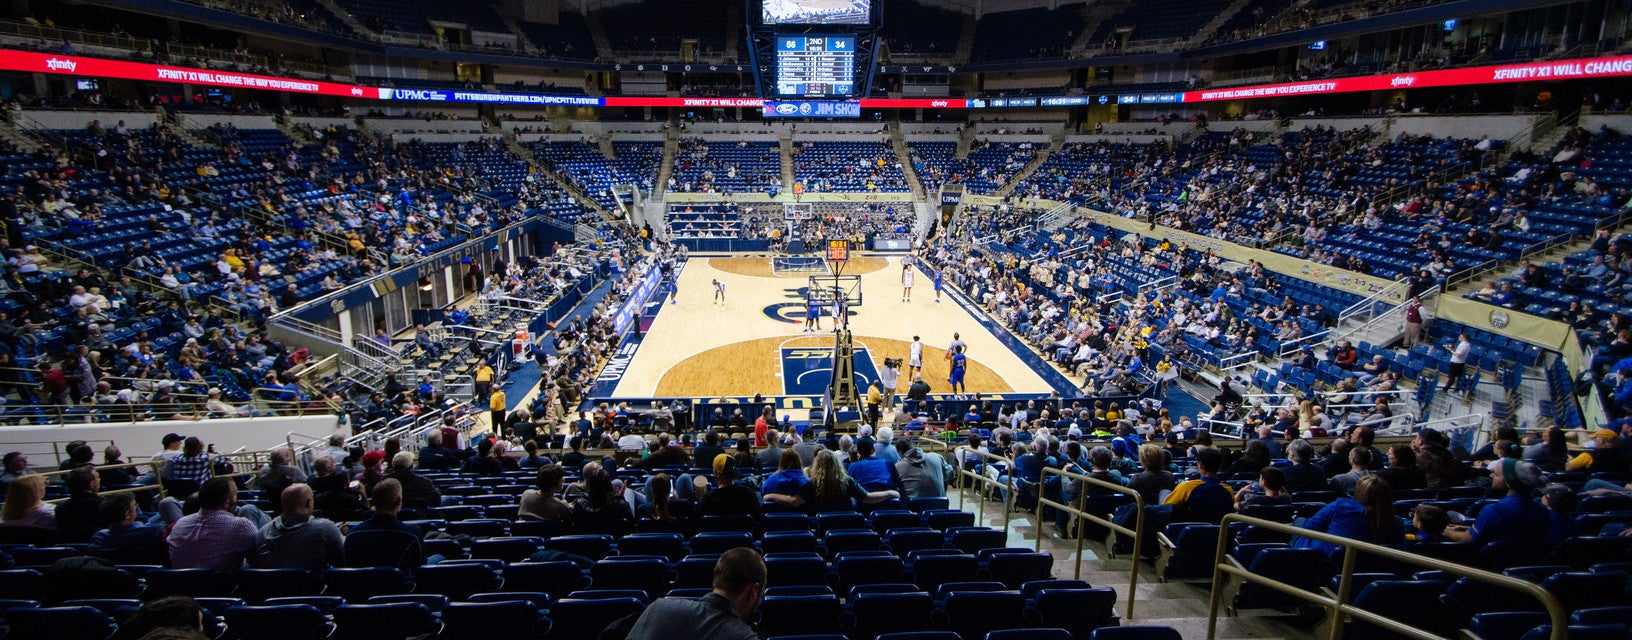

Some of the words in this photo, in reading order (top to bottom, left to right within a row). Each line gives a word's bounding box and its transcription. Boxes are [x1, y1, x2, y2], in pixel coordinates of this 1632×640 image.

[46, 57, 77, 72] xfinity
[1493, 67, 1536, 80] XFINITY
[1537, 66, 1551, 77] X1
[1553, 63, 1582, 76] WILL
[157, 68, 188, 81] XFINITY
[188, 71, 198, 81] X1
[198, 72, 216, 83] WILL
[215, 74, 243, 85] CHANGE
[243, 77, 256, 87] THE
[255, 78, 269, 87] WAY
[268, 79, 281, 89] YOU
[281, 80, 312, 91] EXPERIENCE
[312, 83, 319, 92] TV
[1391, 76, 1413, 87] xfinity
[395, 89, 430, 100] UPMC
[1201, 92, 1219, 100] XFINITY
[1223, 91, 1235, 99] WILL
[1235, 90, 1255, 98] CHANGE
[1255, 88, 1265, 96] THE
[1277, 86, 1289, 94] YOU
[1289, 84, 1326, 93] EXPERIENCE
[1325, 82, 1336, 91] TV
[815, 103, 834, 115] JIM
[418, 258, 445, 278] HAIL
[448, 251, 462, 264] TO
[465, 242, 484, 257] PITT
[597, 354, 632, 381] UPMC
